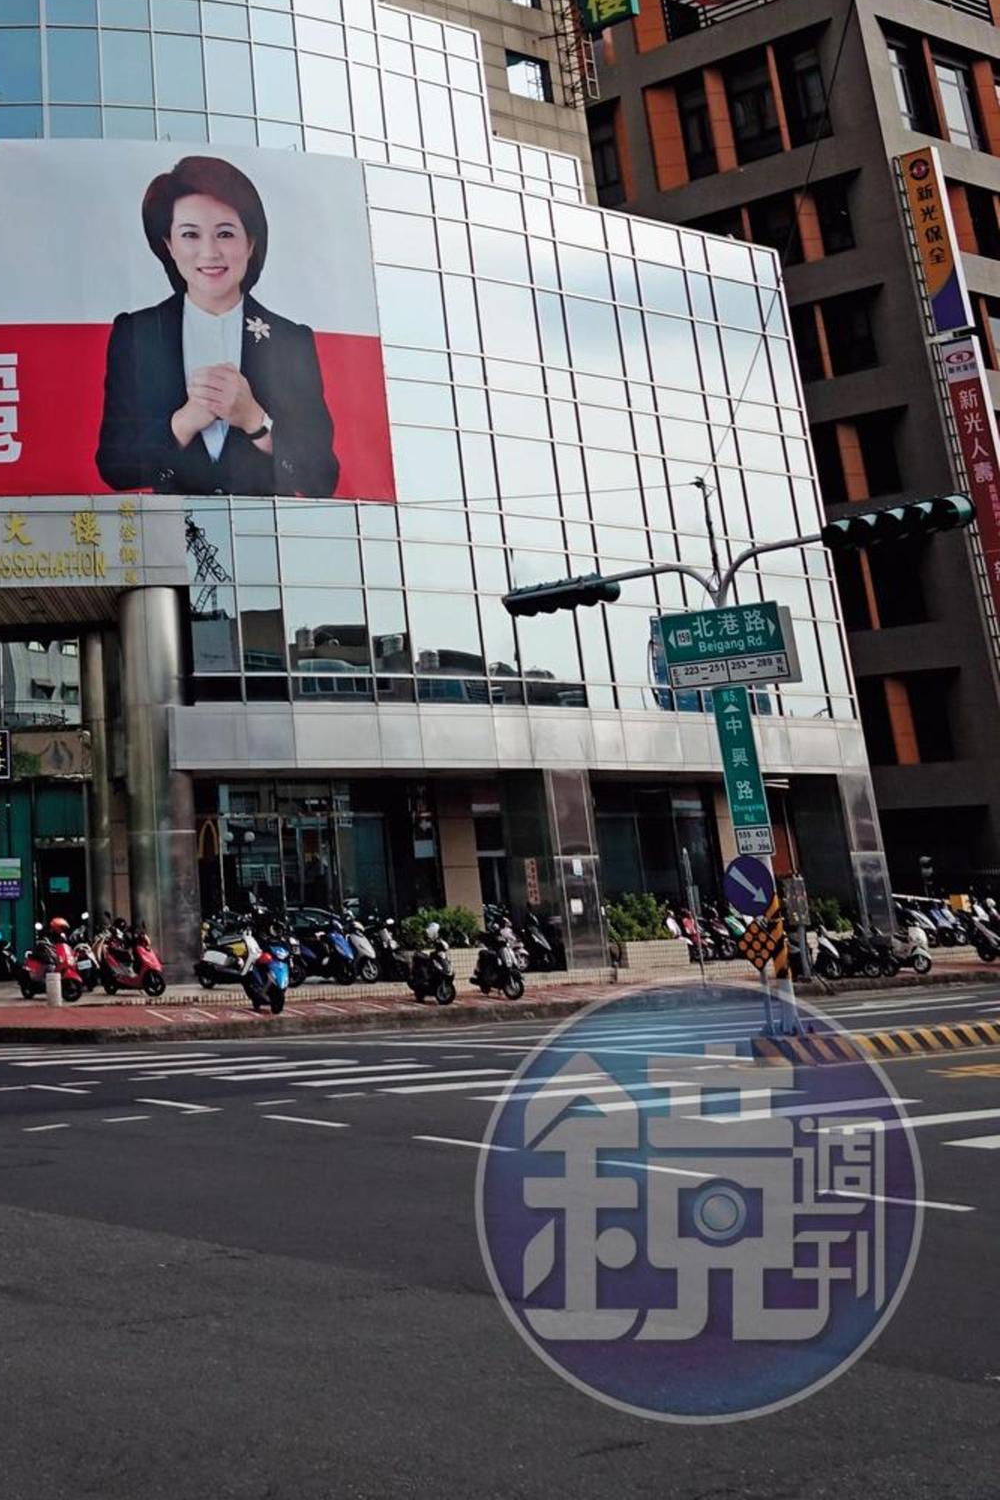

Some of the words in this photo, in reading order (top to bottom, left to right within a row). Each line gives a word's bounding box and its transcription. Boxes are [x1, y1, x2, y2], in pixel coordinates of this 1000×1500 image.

[916, 183, 945, 265] 新光保全
[958, 388, 994, 483] 新光人壽
[692, 609, 766, 639] 北港路
[698, 638, 745, 653] Beigang
[725, 715, 754, 801] 中興路
